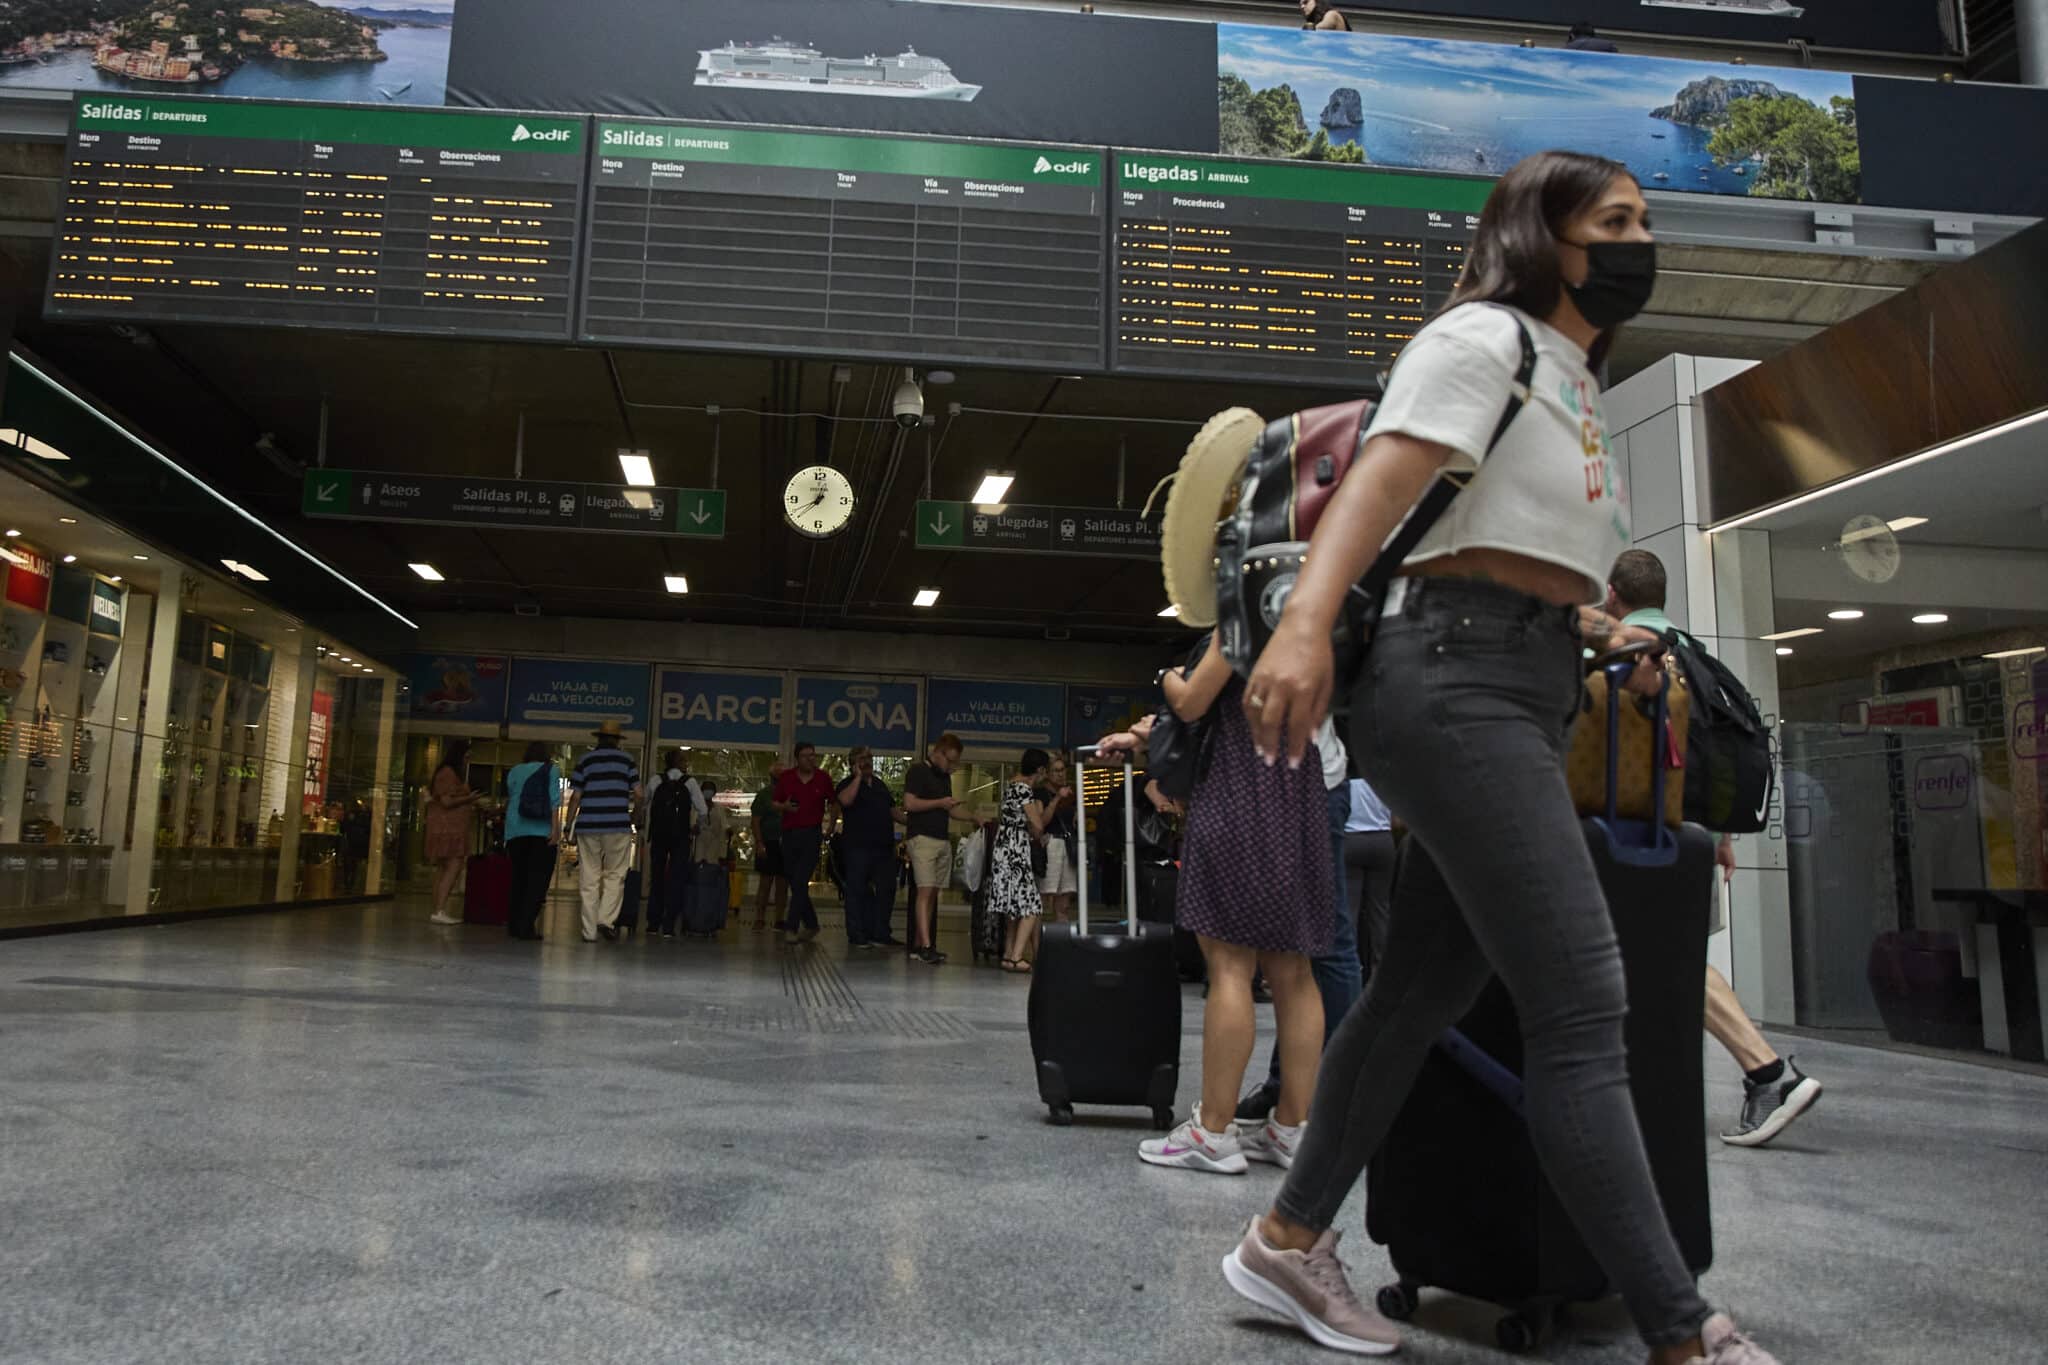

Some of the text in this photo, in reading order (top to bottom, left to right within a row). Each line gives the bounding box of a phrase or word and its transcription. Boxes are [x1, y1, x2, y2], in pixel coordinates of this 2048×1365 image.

[82, 103, 207, 123] Salidas DEPARTURES
[79, 133, 100, 142] Hora
[128, 135, 161, 145] Destino
[532, 128, 572, 142] adif
[603, 129, 729, 150] Salidas DEPARTURES
[314, 144, 334, 154] Tren
[439, 150, 501, 162] Observaciones
[602, 159, 623, 168] Hora
[651, 162, 685, 172] Destino
[1053, 161, 1091, 174] adif
[837, 172, 856, 182] Tren
[1124, 163, 1249, 184] Llegadas ARRIVALS
[964, 181, 1024, 194] Observaciones
[1123, 191, 1143, 201] Hora
[1173, 197, 1225, 209] Procedencia
[1348, 206, 1366, 216] Tren
[814, 472, 827, 481] 12
[380, 482, 421, 497] Aseos
[463, 487, 552, 504] Salidas Pl. B.
[790, 495, 798, 504] 9
[840, 496, 848, 505] 3
[814, 520, 823, 529] 6
[997, 515, 1049, 531] Llegadas
[1084, 519, 1131, 533] Salidas
[1135, 522, 1152, 535] Pl.
[551, 681, 609, 693] VIAJA EN
[527, 692, 635, 706] ALTA VELOCIDAD
[969, 700, 1025, 713] VIAJA EN
[945, 712, 1051, 727] ALTA VELOCIDAD
[1917, 768, 1969, 796] renfe
